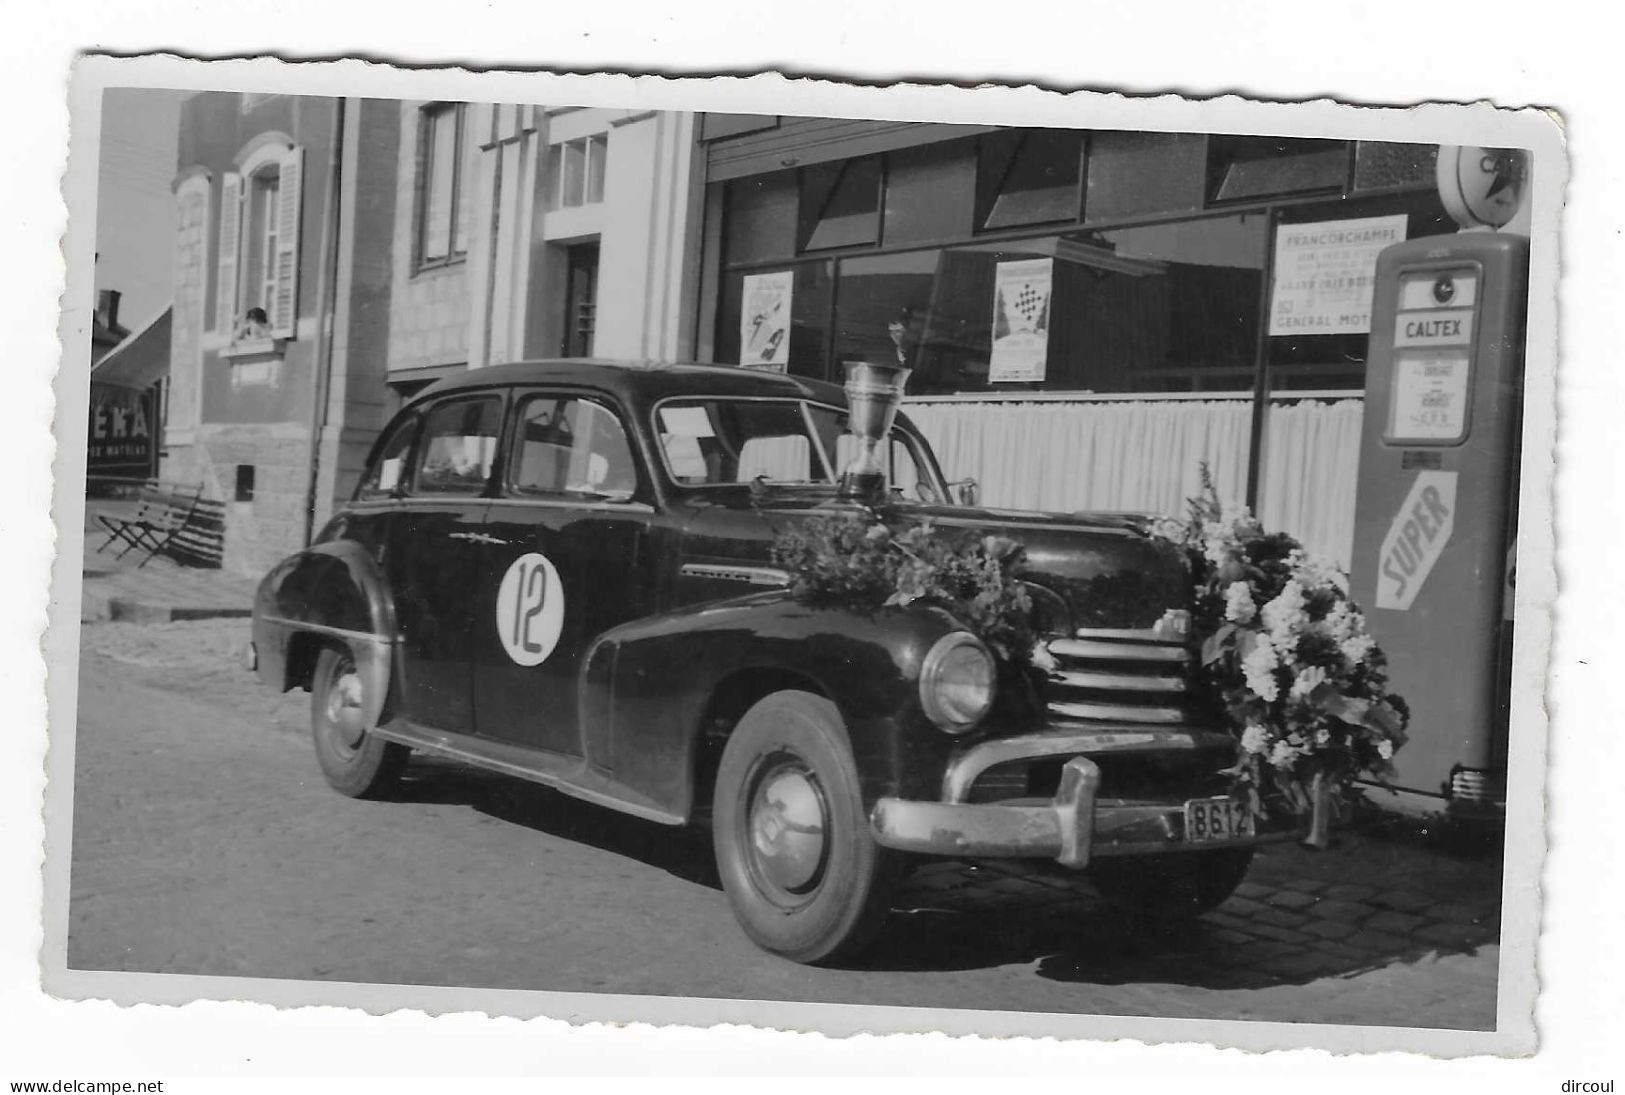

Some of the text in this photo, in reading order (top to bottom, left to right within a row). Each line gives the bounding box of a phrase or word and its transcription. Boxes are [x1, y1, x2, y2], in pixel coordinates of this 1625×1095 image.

[1286, 230, 1396, 246] FRANCORCHAMPS
[1277, 314, 1331, 328] GENERAL
[1406, 320, 1461, 338] CALTEX
[1383, 485, 1449, 599] SUPER
[513, 562, 547, 654] 12
[1195, 803, 1247, 837] 8612
